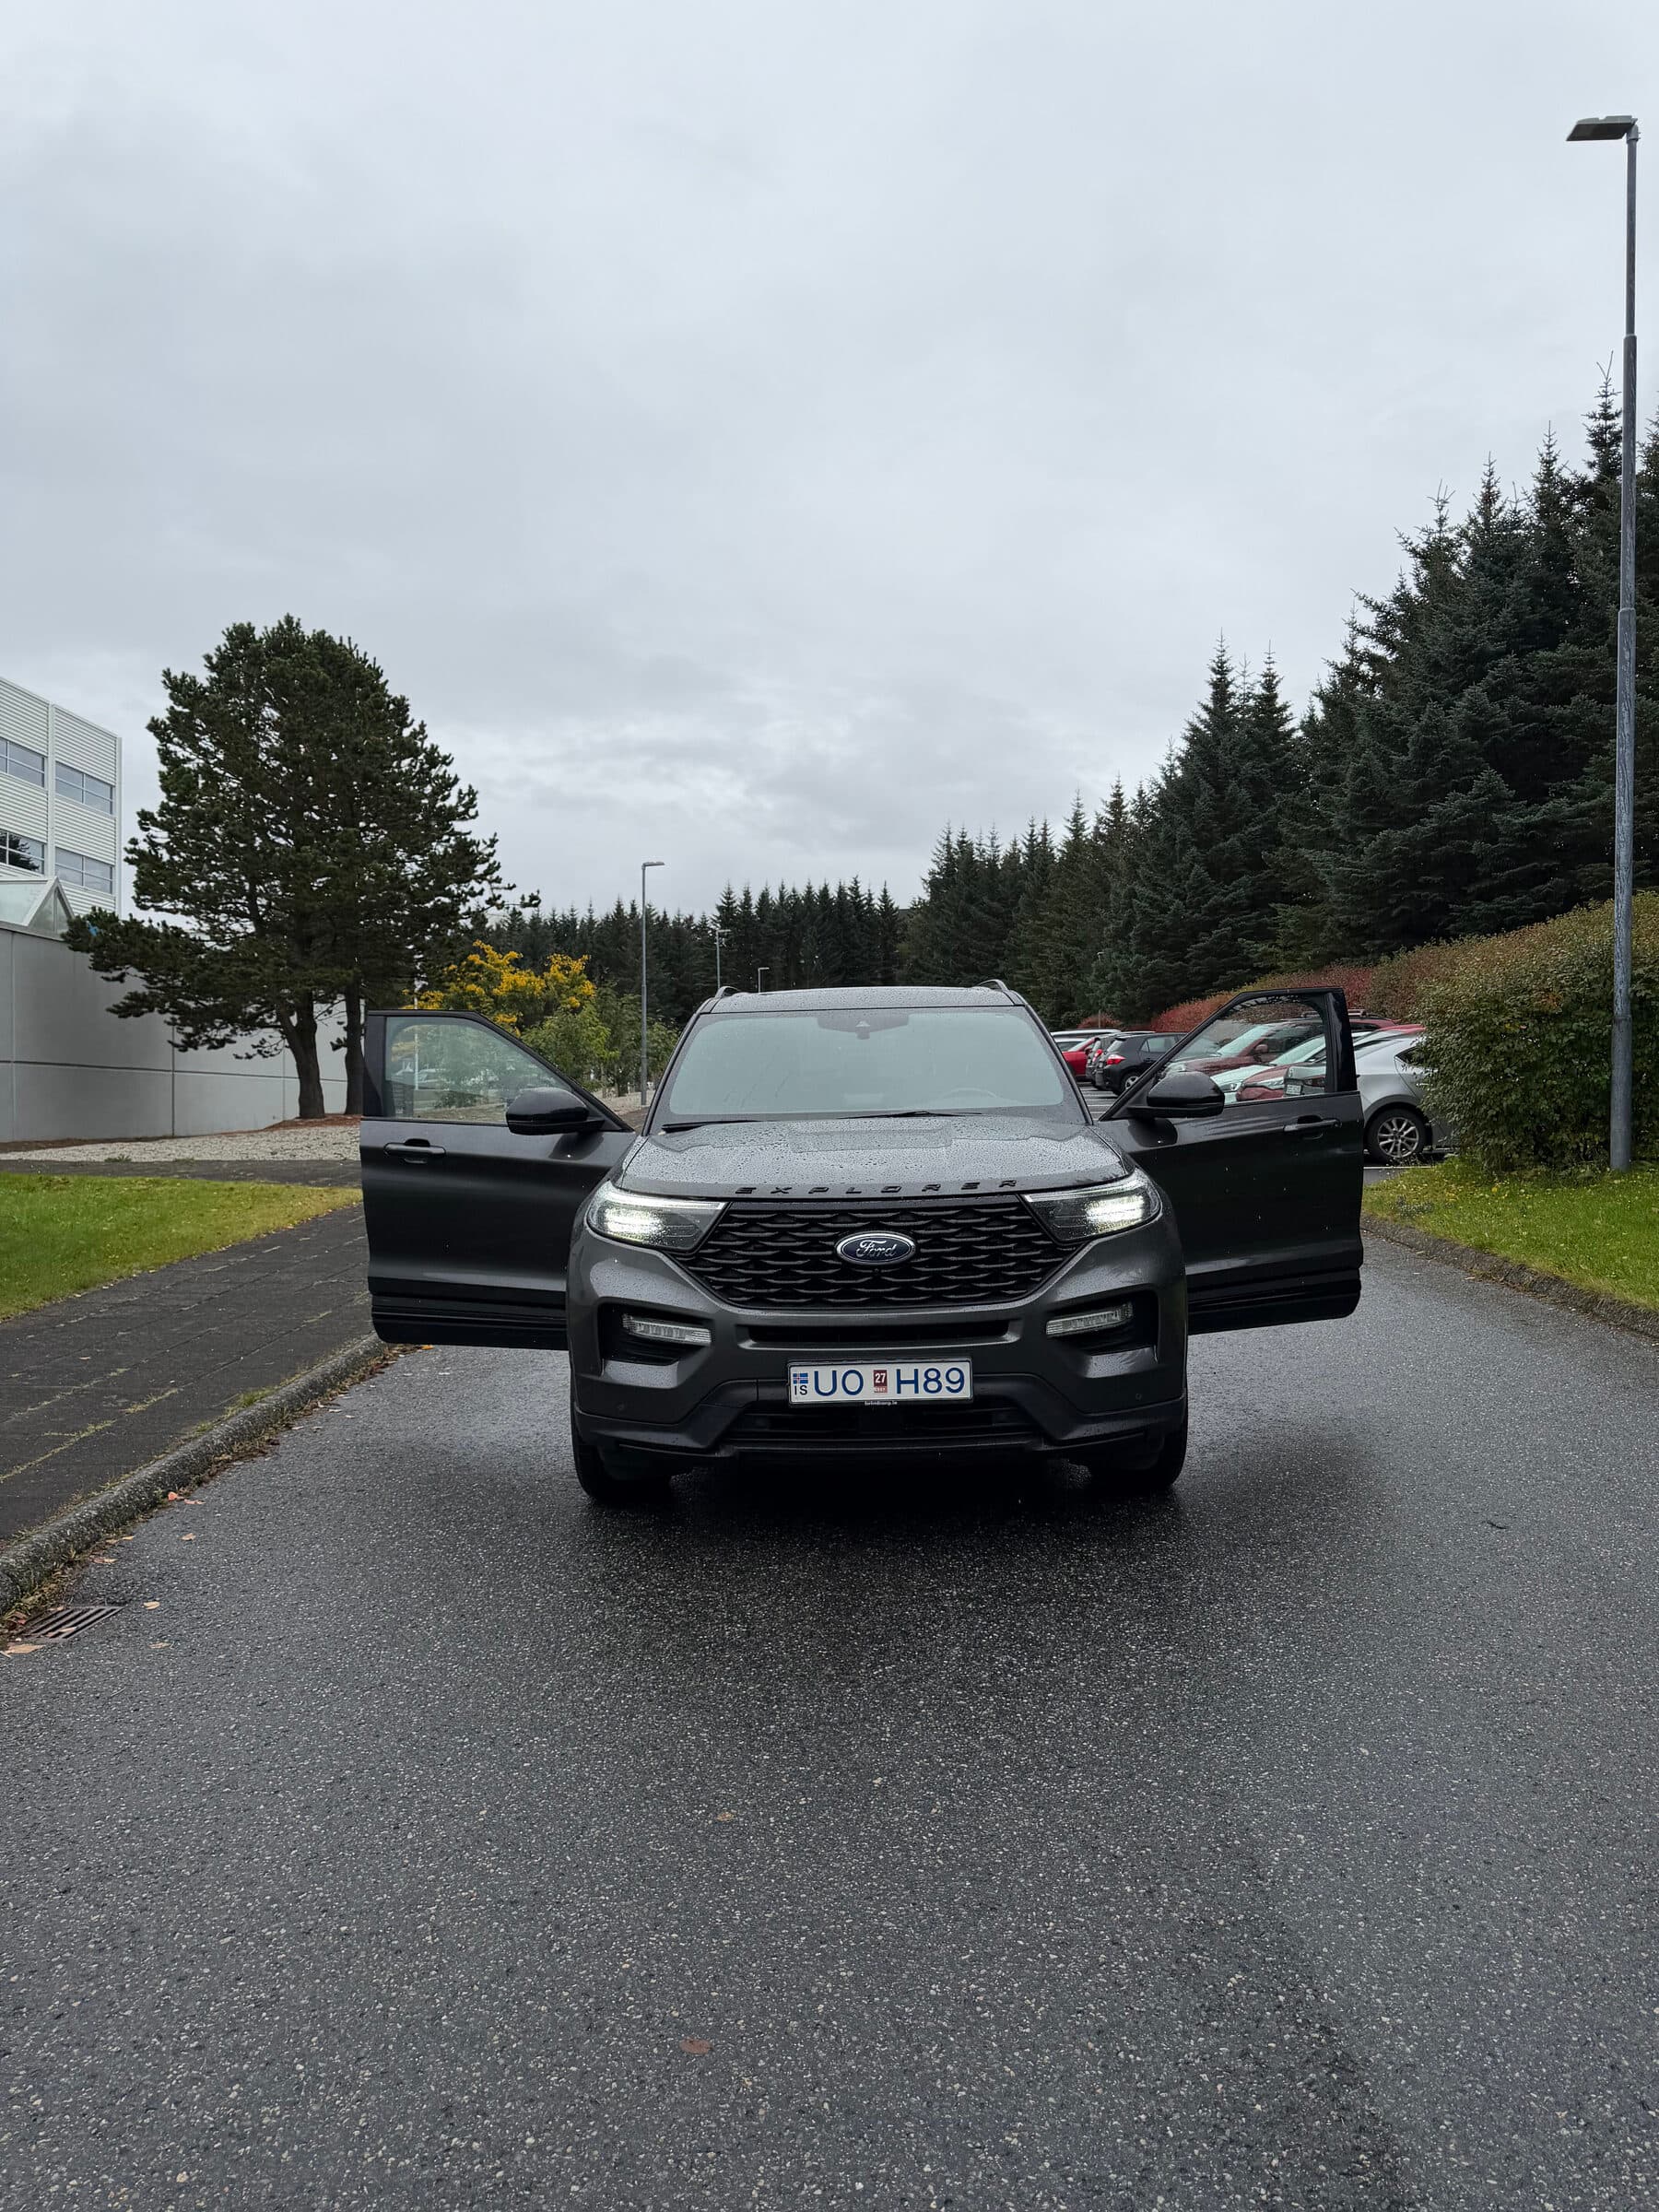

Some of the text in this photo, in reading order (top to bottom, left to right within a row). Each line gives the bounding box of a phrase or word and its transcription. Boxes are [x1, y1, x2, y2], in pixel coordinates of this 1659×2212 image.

[735, 1180, 1018, 1194] EXPLORER
[856, 1239, 897, 1259] Ford
[814, 1368, 965, 1396] UO H89
[875, 1372, 886, 1383] 27
[794, 1384, 808, 1395] IS
